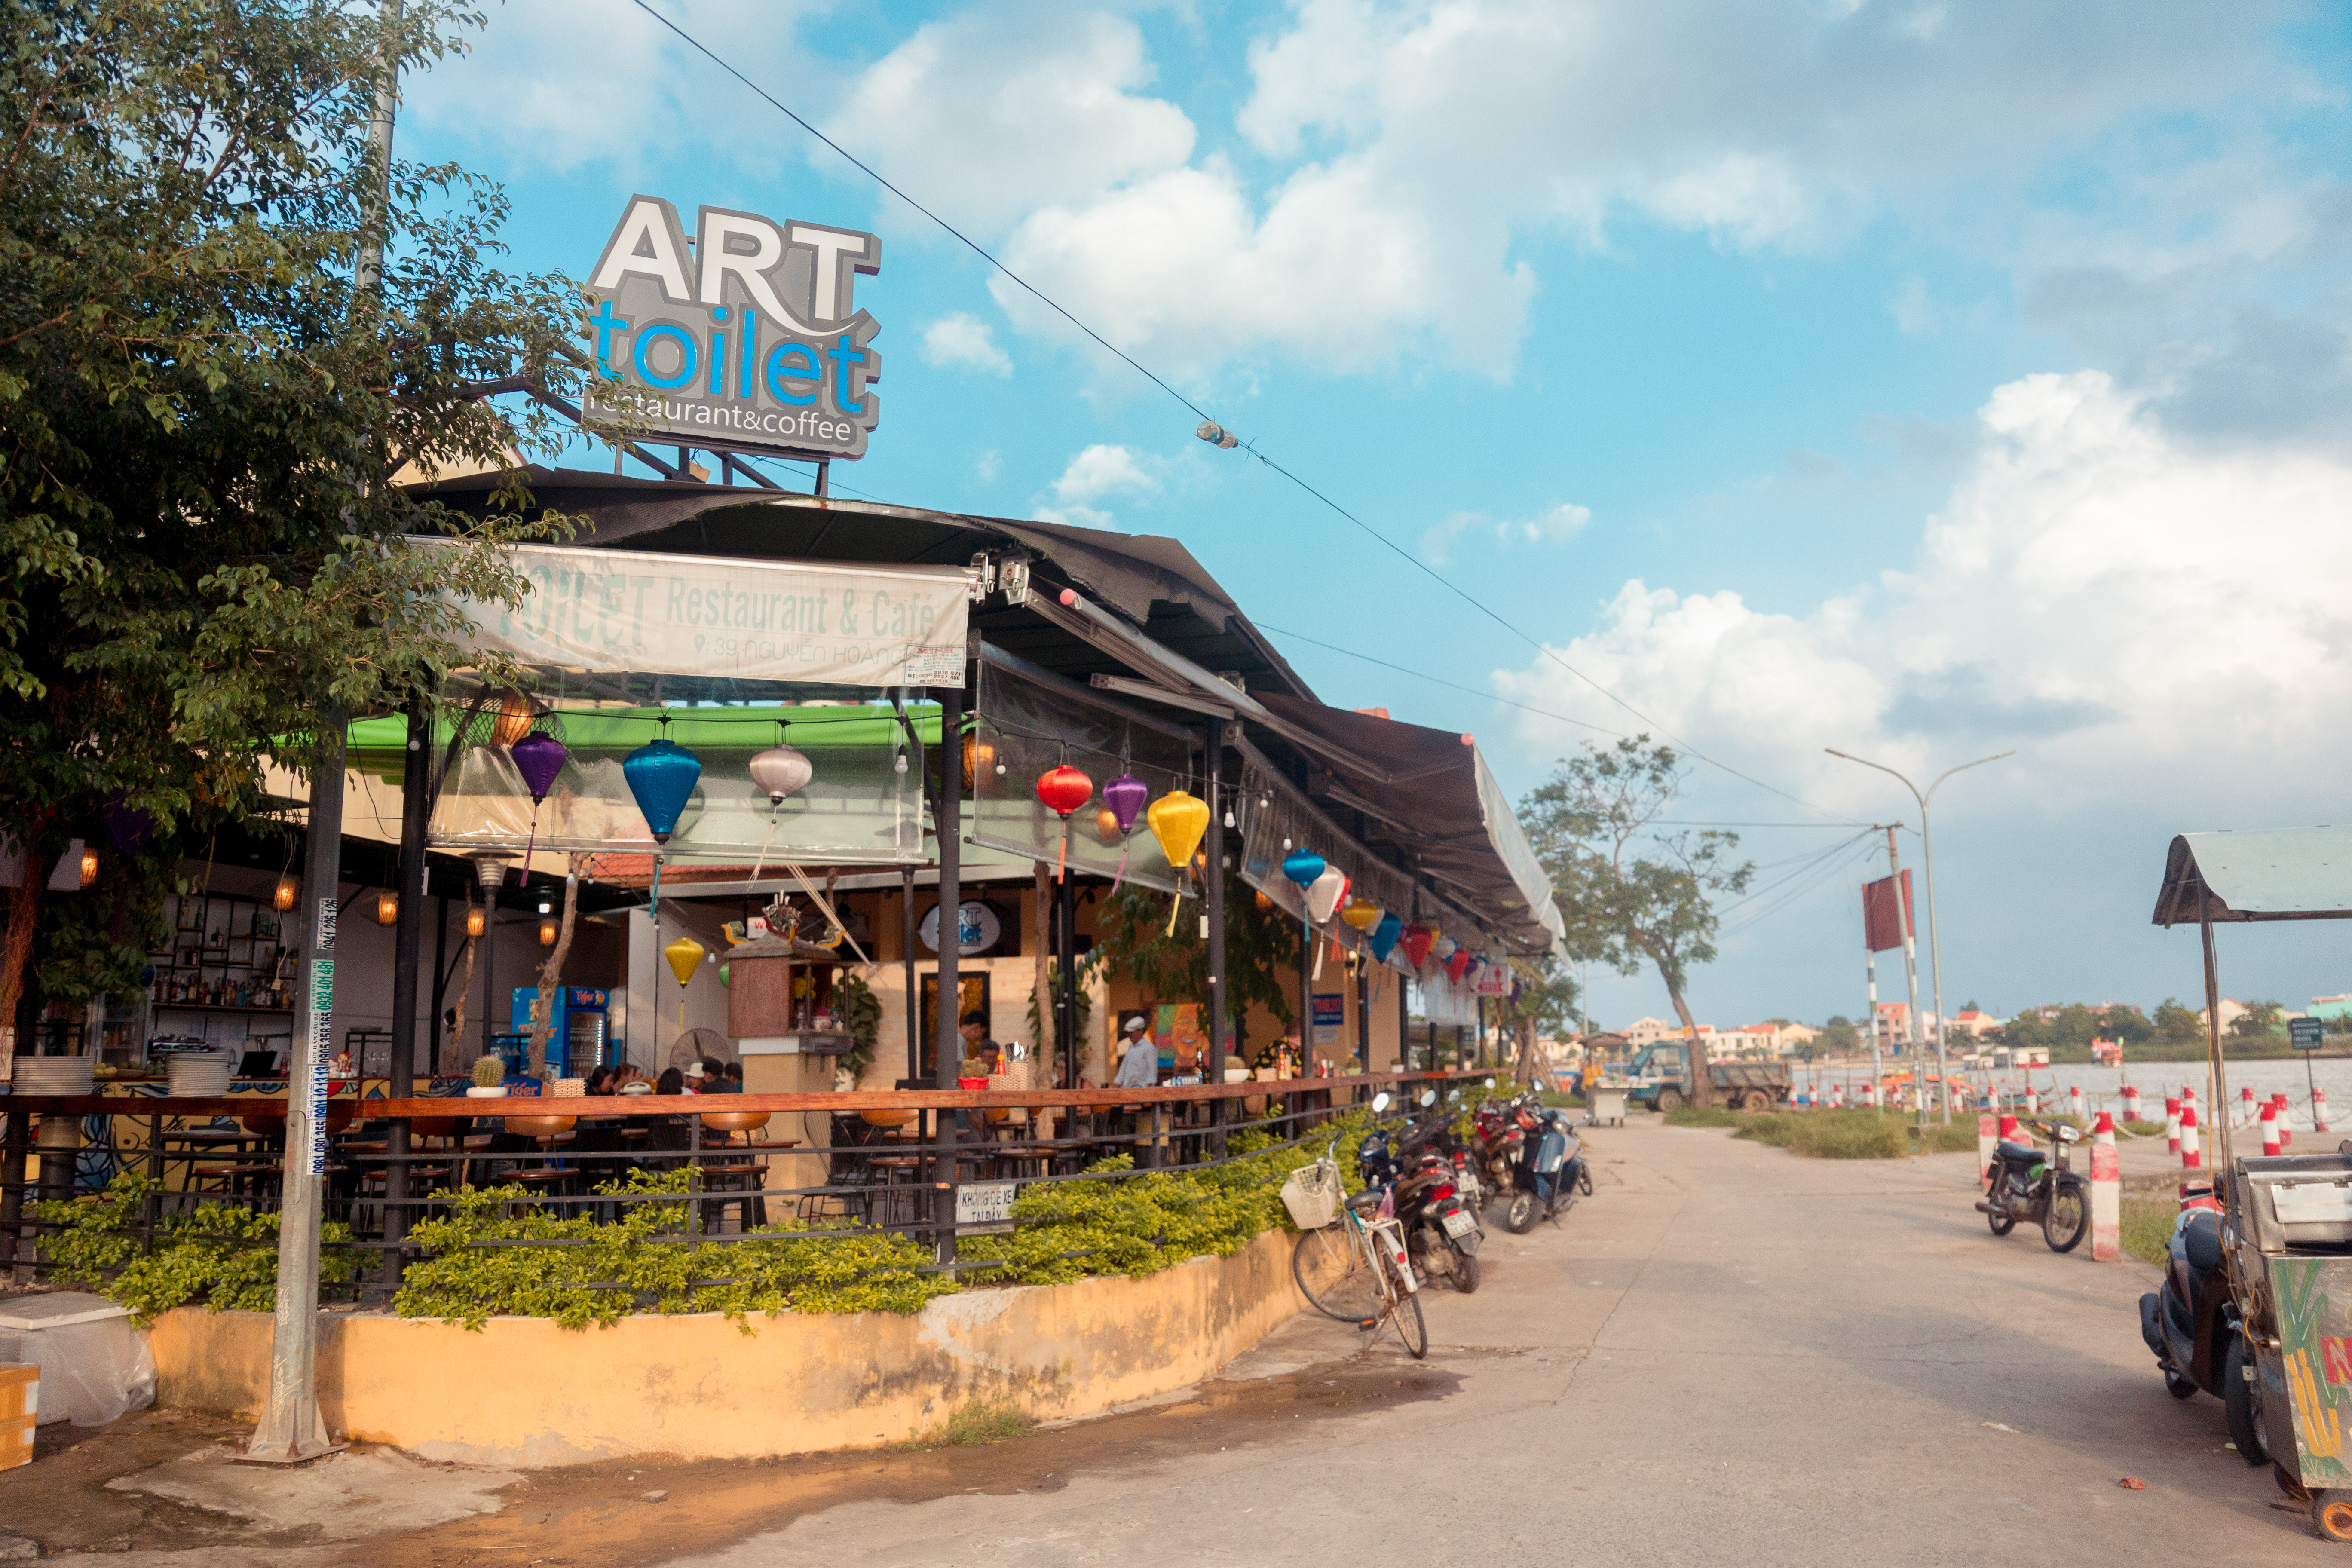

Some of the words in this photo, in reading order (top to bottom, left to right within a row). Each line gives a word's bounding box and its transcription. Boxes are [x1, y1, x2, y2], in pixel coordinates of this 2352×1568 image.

[594, 201, 864, 337] ART
[590, 301, 864, 413] toilet
[666, 574, 827, 634] Restaurant
[840, 588, 858, 636] &
[872, 589, 934, 639] Café
[714, 637, 737, 657] 39
[324, 899, 337, 913] 126
[323, 916, 337, 929] 226
[316, 961, 334, 1010] 0932.401.481
[576, 990, 594, 1005] Tiger
[502, 1082, 539, 1097] Tiger
